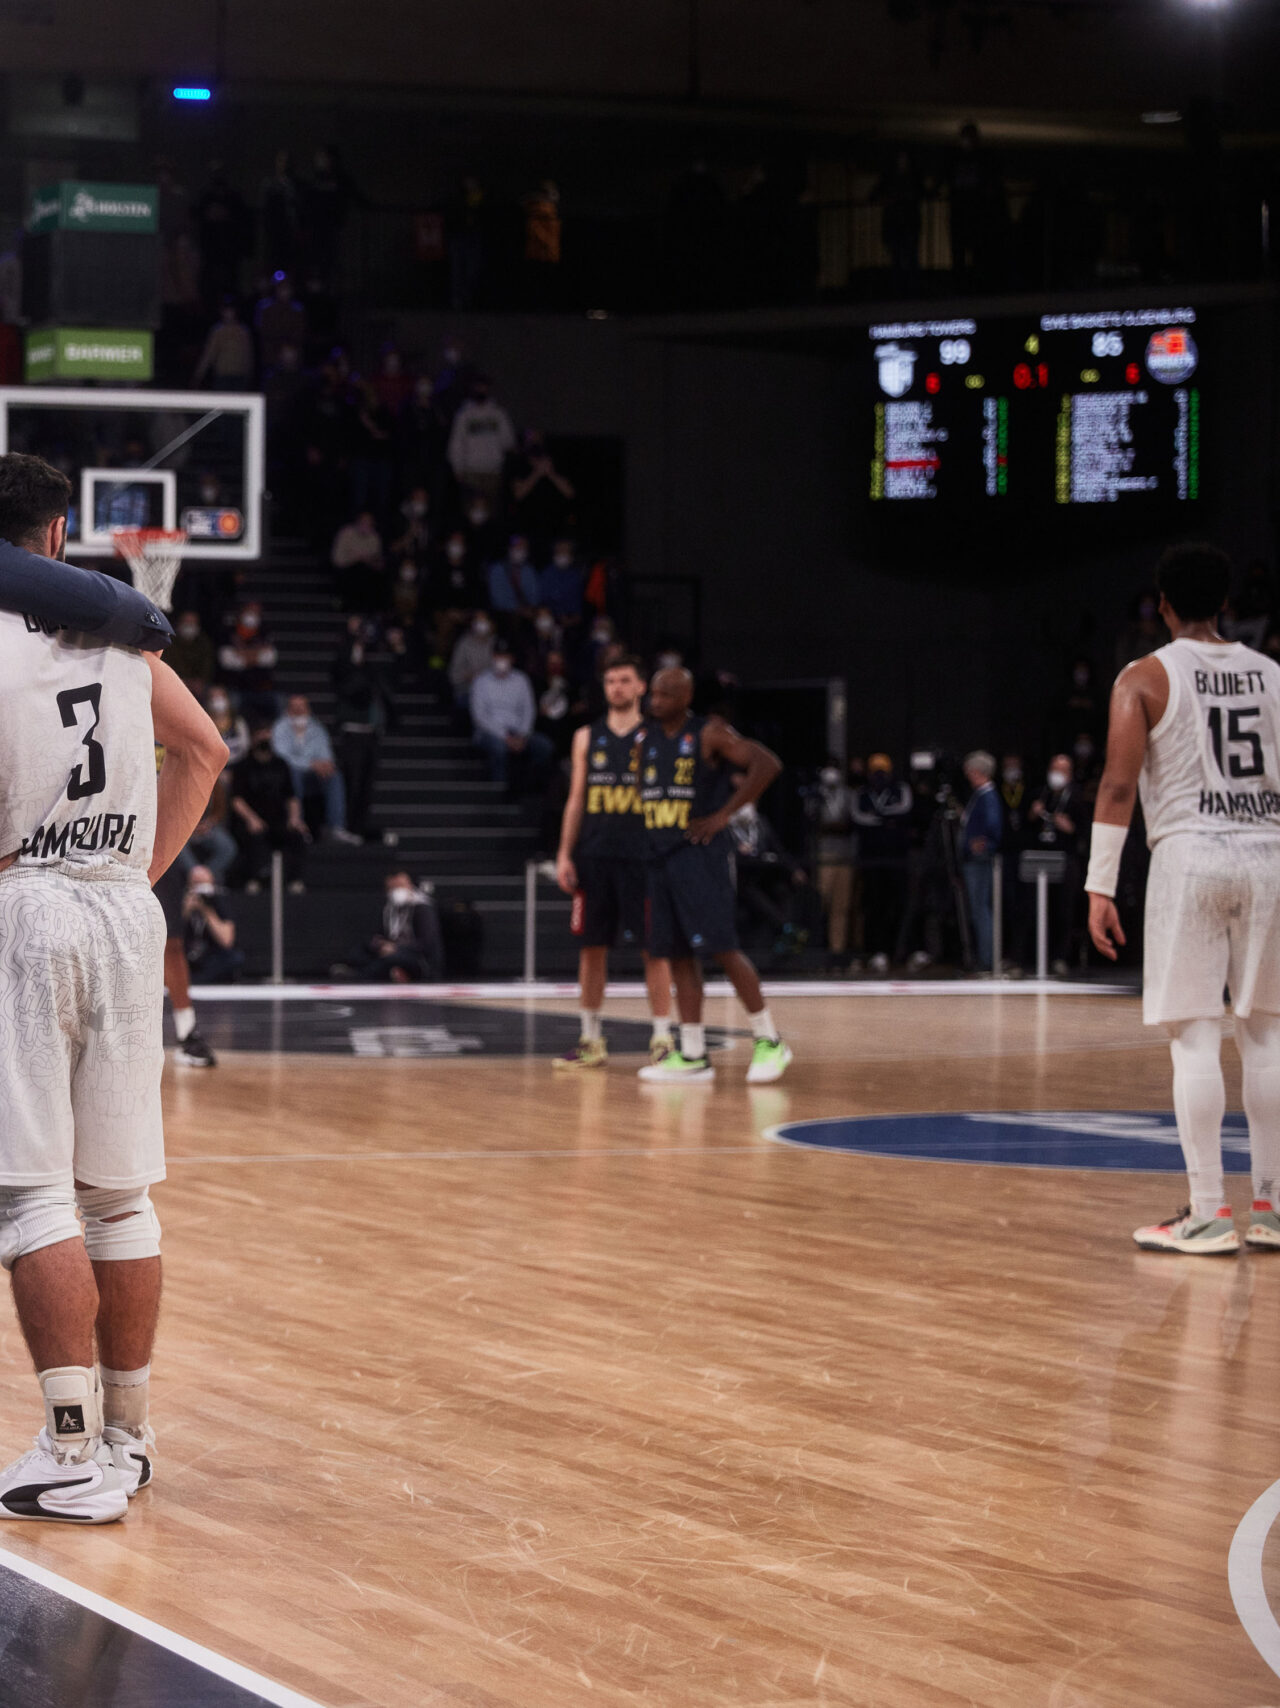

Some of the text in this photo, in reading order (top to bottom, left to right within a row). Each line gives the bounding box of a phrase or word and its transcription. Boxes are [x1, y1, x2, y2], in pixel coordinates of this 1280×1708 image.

[64, 342, 143, 364] BARMER
[56, 682, 107, 801] 3
[1207, 706, 1265, 779] 15
